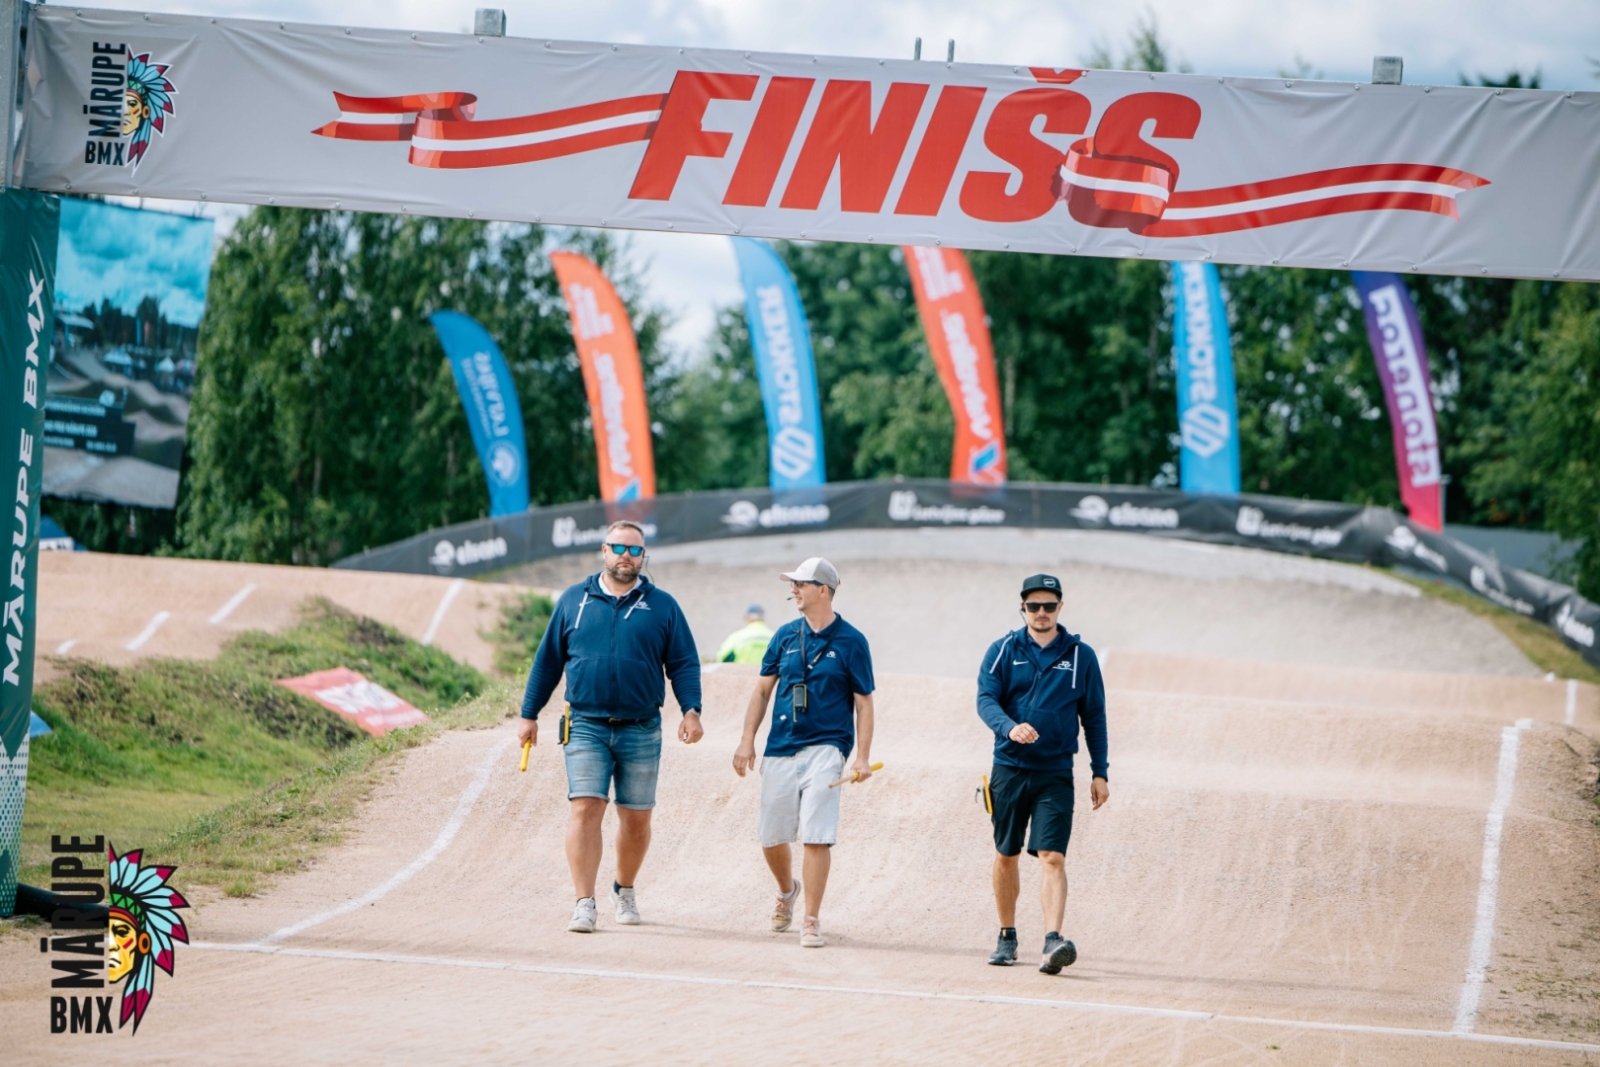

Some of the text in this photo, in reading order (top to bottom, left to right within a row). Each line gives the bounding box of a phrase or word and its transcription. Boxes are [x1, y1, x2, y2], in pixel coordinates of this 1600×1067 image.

[83, 41, 126, 138] MĀRUPE
[84, 140, 125, 166] BMX
[628, 67, 1202, 229] FINIŠS
[3, 268, 45, 687] MĀRUPE BMX
